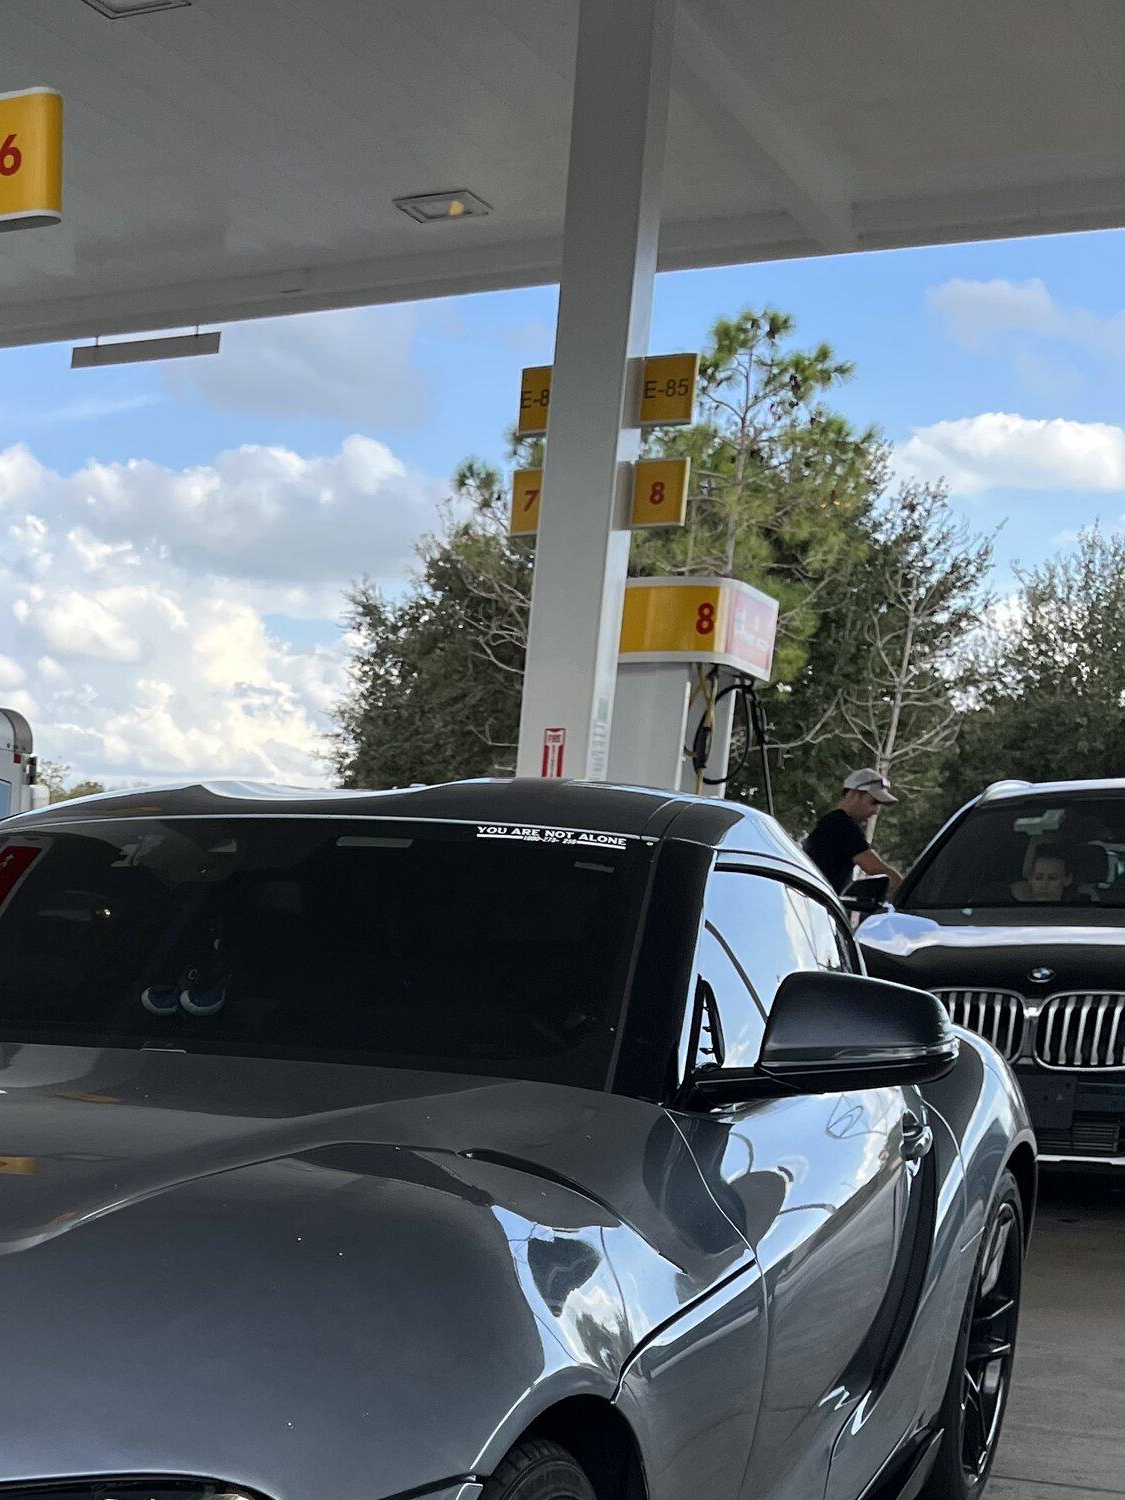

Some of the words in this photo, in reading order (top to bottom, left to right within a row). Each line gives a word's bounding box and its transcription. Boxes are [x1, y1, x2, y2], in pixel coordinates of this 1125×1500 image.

[520, 389, 550, 409] E-8
[643, 378, 689, 400] E-85
[523, 490, 540, 512] 7
[649, 480, 665, 505] 8
[695, 602, 715, 635] 8
[477, 826, 508, 834] YOU
[511, 827, 540, 836] ARE
[544, 829, 574, 839] NOT
[578, 833, 627, 846] ALONE
